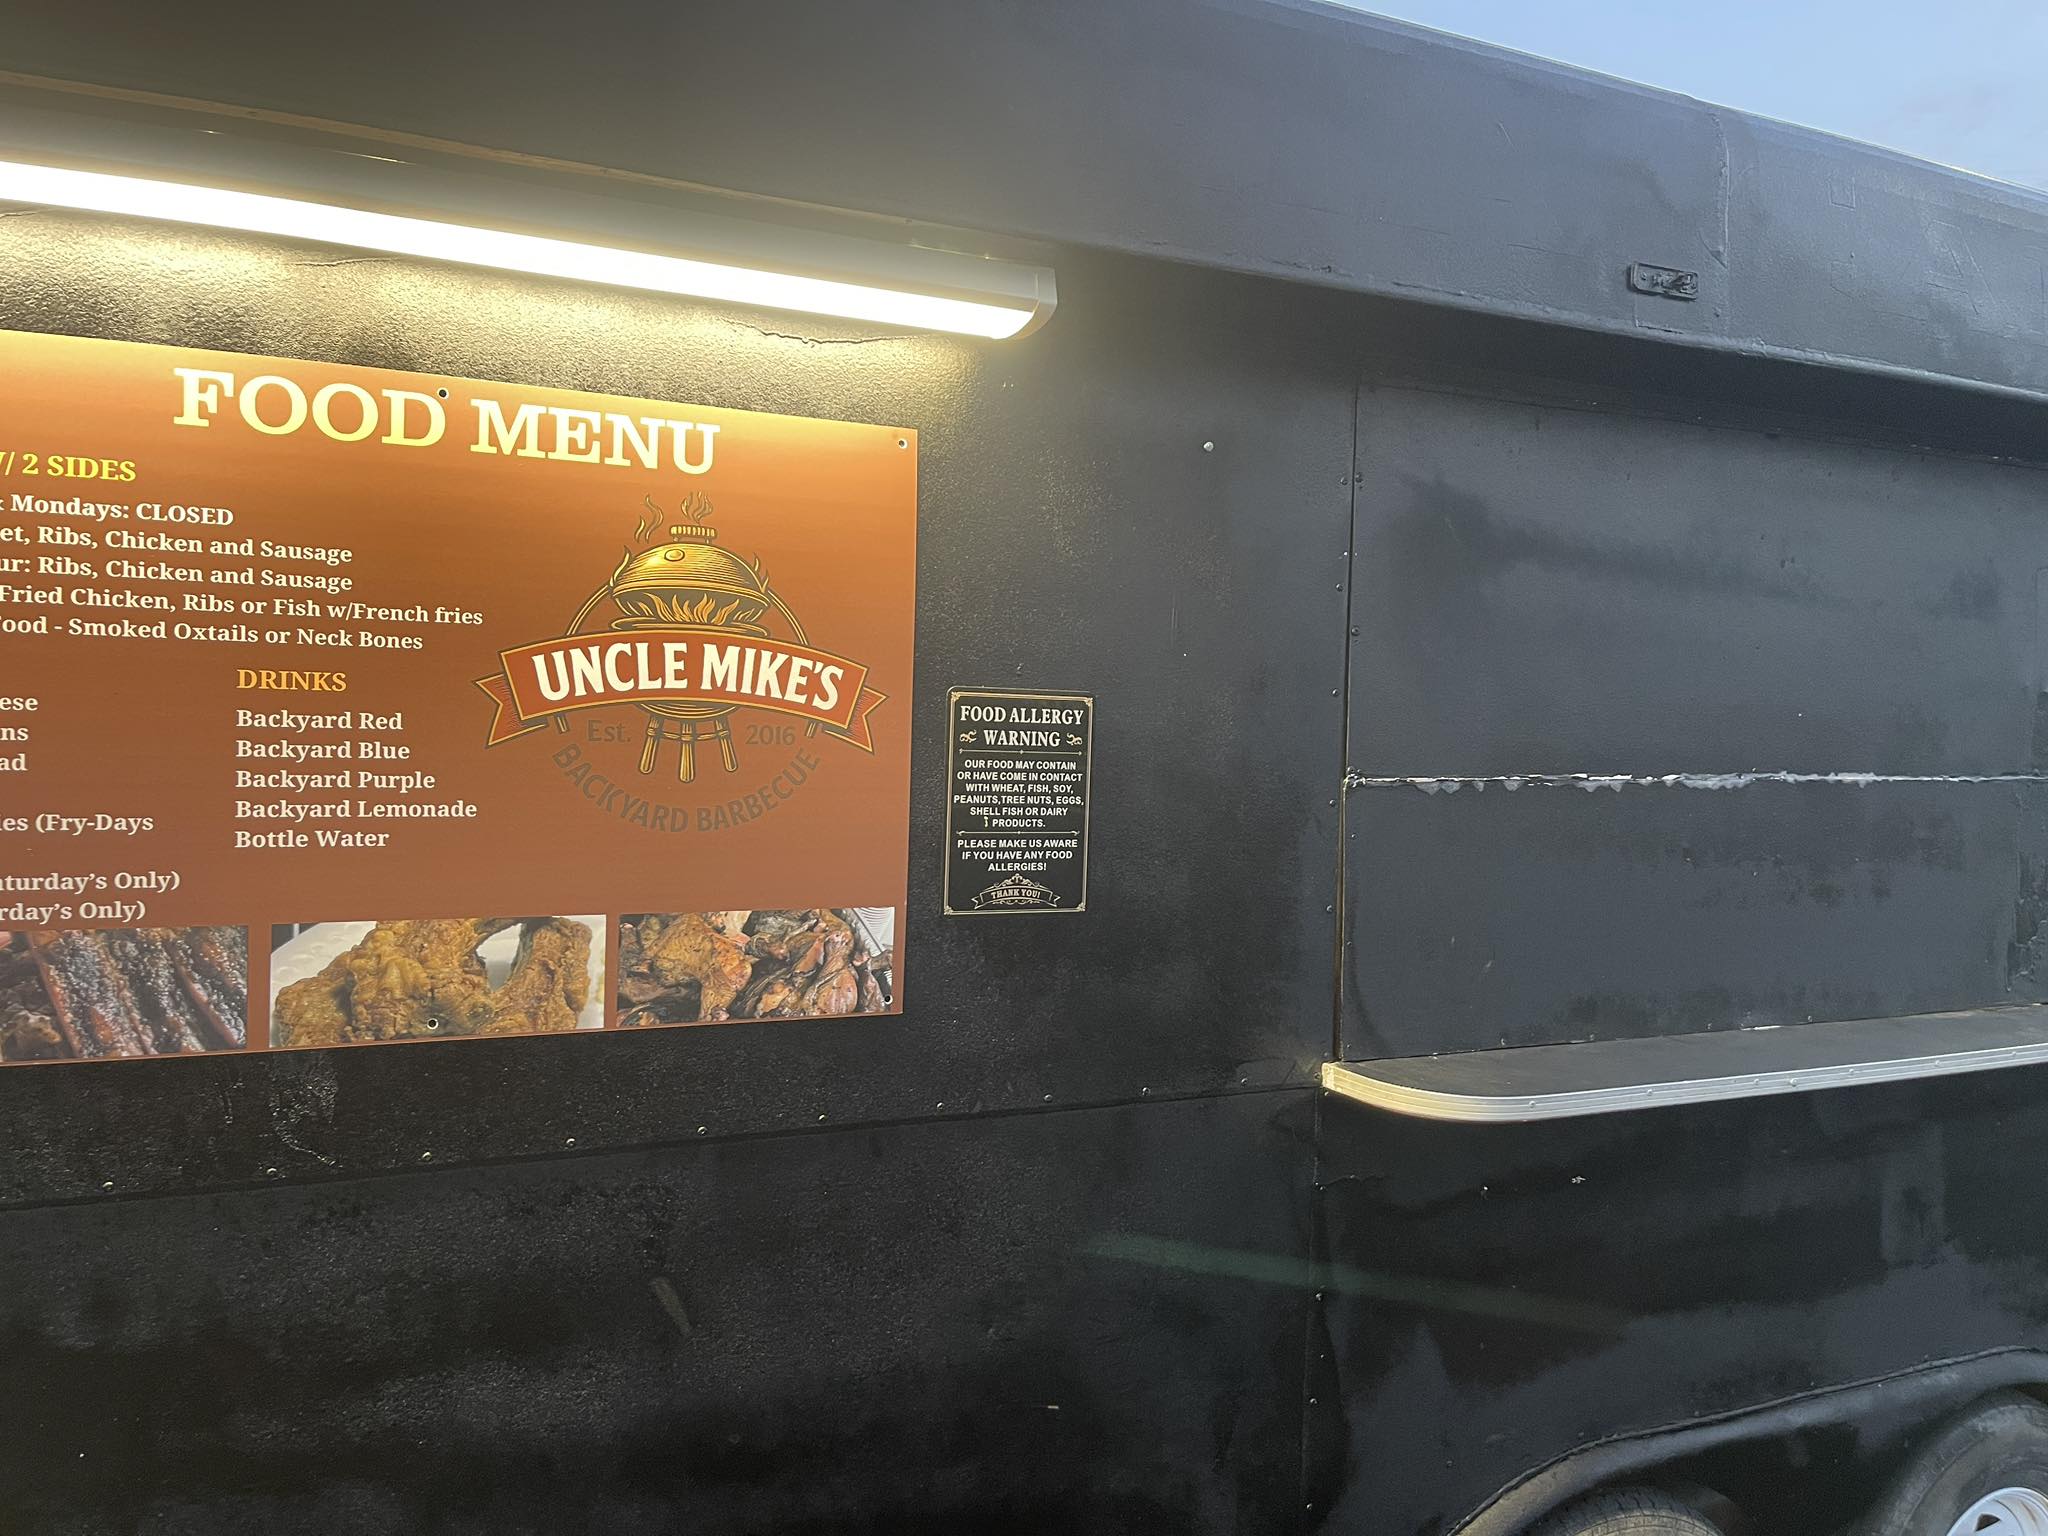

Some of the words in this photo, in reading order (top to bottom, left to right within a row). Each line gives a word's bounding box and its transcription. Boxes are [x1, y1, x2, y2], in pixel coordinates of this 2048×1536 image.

[173, 367, 446, 447] FOOD
[470, 398, 722, 476] MENU
[21, 453, 39, 475] 2
[47, 456, 137, 482] SIDES
[10, 494, 130, 520] Mondays:
[135, 503, 234, 526] CLOSED
[37, 527, 98, 549] Ribs,
[105, 530, 203, 554] Chicken
[209, 536, 255, 557] and
[260, 541, 353, 566] Sausage
[37, 556, 98, 578] Ribs,
[105, 559, 203, 582] Chicken
[210, 565, 255, 586] and
[260, 569, 353, 594] Sausage
[0, 584, 63, 605] Fried
[70, 587, 177, 613] Chicken,
[183, 594, 236, 615] Ribs
[241, 599, 266, 615] or
[273, 598, 321, 618] Fish
[326, 601, 429, 623] w/French
[434, 606, 484, 625] fries
[0, 616, 48, 635] ood
[68, 618, 167, 640] Smoked
[173, 622, 259, 643] Oxtails
[265, 628, 291, 644] or
[297, 627, 353, 648] Neck
[358, 630, 424, 650] Bones
[236, 669, 348, 692] DRINKS
[532, 641, 688, 702] UNCLE
[700, 643, 844, 711] MIKE’S
[235, 709, 352, 735] Backyard
[358, 712, 403, 731] Red
[960, 705, 1006, 722] FOOD
[1009, 707, 1084, 725] ALLERGY
[586, 718, 632, 742] Est.
[745, 723, 796, 746] 2016
[984, 729, 1060, 747] WARNING
[235, 739, 352, 764] Backyard
[357, 741, 410, 760] Blue
[957, 771, 972, 781] OR
[973, 771, 998, 781] HAVE
[1000, 772, 1026, 781] COME
[1029, 772, 1038, 781] IN
[1040, 772, 1082, 782] CONTACT
[965, 759, 985, 769] OUR
[987, 760, 1013, 769] FOOD
[1015, 760, 1035, 769] MAY
[1036, 761, 1076, 770] CONTAIN
[235, 769, 352, 794] Backyard
[357, 770, 436, 794] Purple
[552, 741, 690, 833] BACKYARD
[696, 747, 822, 833] BARBECUE
[966, 783, 991, 792] WITH
[992, 783, 1026, 794] WHEAT,
[1028, 784, 1051, 794] FISH,
[1053, 784, 1073, 794] SOY,
[235, 799, 352, 824] Backyard
[357, 799, 478, 819] Lemonade
[970, 807, 1000, 815] SHELL
[1002, 807, 1023, 815] FISH
[1025, 807, 1039, 815] OR
[1040, 807, 1068, 815] DAIRY
[1027, 796, 1054, 805] NUTS,
[1056, 796, 1084, 805] EGGS,
[34, 813, 155, 837] (Fry-Days
[992, 818, 1045, 828] PRODUCTS.
[234, 829, 309, 849] Bottle
[314, 829, 390, 849] Water
[957, 839, 996, 848] PLEASE
[999, 839, 1027, 848] MAKE
[1029, 839, 1042, 848] US
[1043, 839, 1077, 848] AWARE
[962, 851, 971, 860] IF
[973, 851, 994, 860] YOU
[996, 851, 1024, 860] HAVE
[1025, 851, 1044, 859] ANY
[1046, 851, 1073, 859] FOOD
[988, 862, 1047, 872] ALLERGIES!
[114, 869, 181, 892] Only)
[991, 889, 1020, 899] THANK
[1021, 889, 1040, 898] YOU!
[79, 899, 147, 924] Only)
